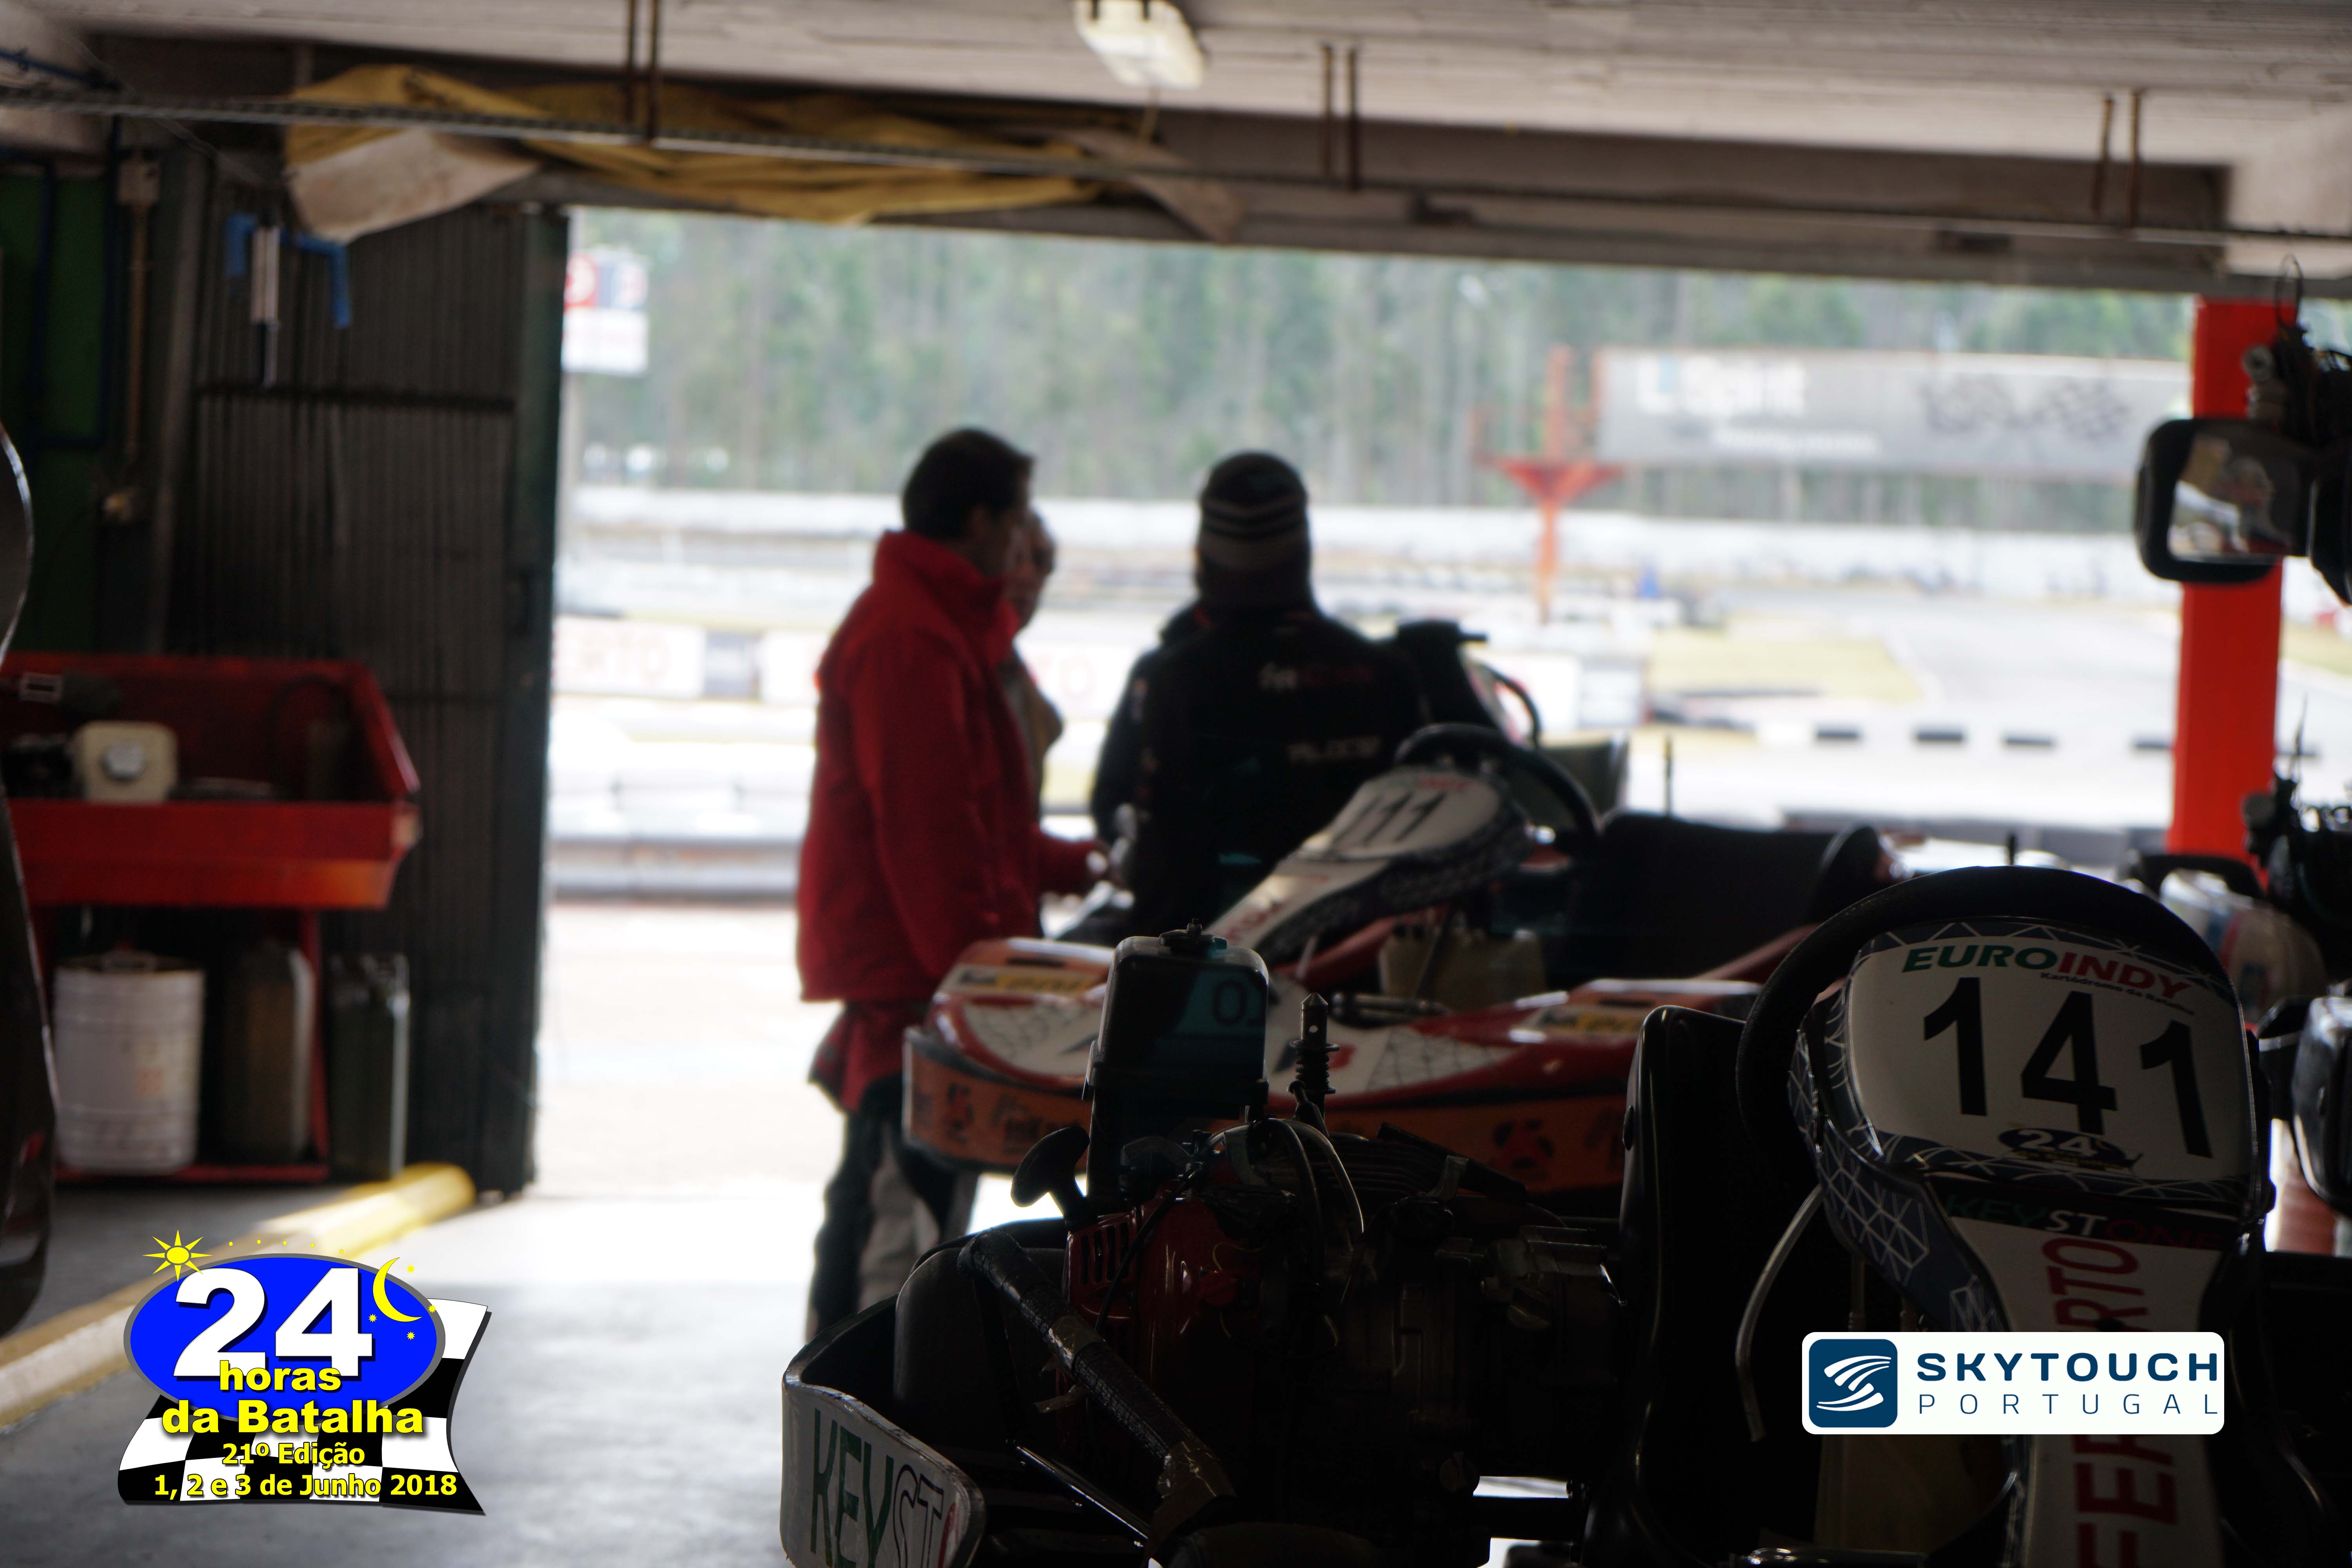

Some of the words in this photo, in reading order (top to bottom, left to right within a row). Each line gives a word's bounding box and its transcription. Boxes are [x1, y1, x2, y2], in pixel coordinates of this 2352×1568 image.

[1901, 944, 2191, 999] EUROINDY
[1923, 977, 2212, 1158] 141
[2018, 1128, 2098, 1157] 24
[1944, 1194, 2227, 1249] KEYSTONE
[810, 1407, 956, 1568] KEYST
